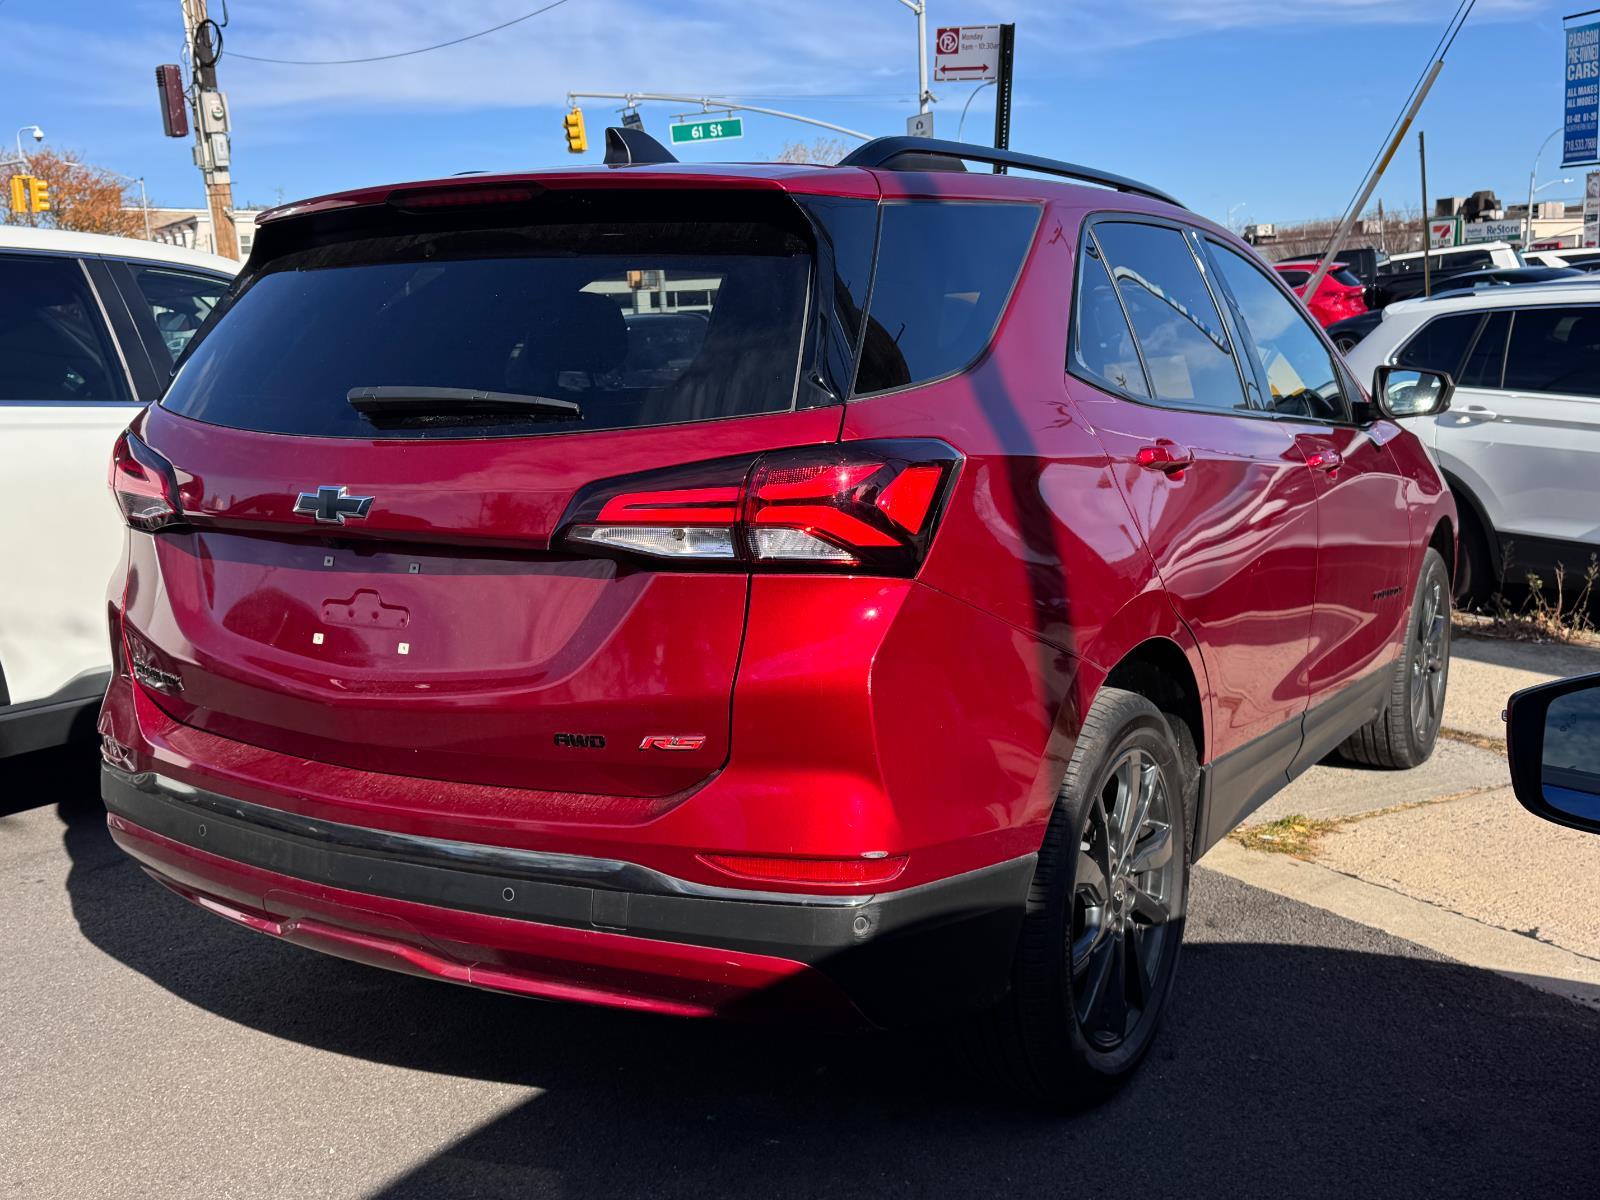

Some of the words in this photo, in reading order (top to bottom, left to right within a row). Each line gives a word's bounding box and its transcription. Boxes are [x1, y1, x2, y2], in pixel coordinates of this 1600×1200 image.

[961, 33, 984, 41] Monday
[1568, 29, 1599, 47] PARAGON
[1568, 43, 1599, 64] PRE-OWNED
[1567, 61, 1599, 81] CARS
[1567, 88, 1577, 97] ALL
[1578, 86, 1598, 96] MAKES
[1567, 98, 1576, 108] ALL
[1577, 95, 1598, 106] MODELS
[691, 126, 703, 138] 61
[709, 124, 723, 136] St
[1486, 223, 1519, 235] ReStore
[554, 733, 606, 748] AWD
[639, 735, 706, 751] RS
